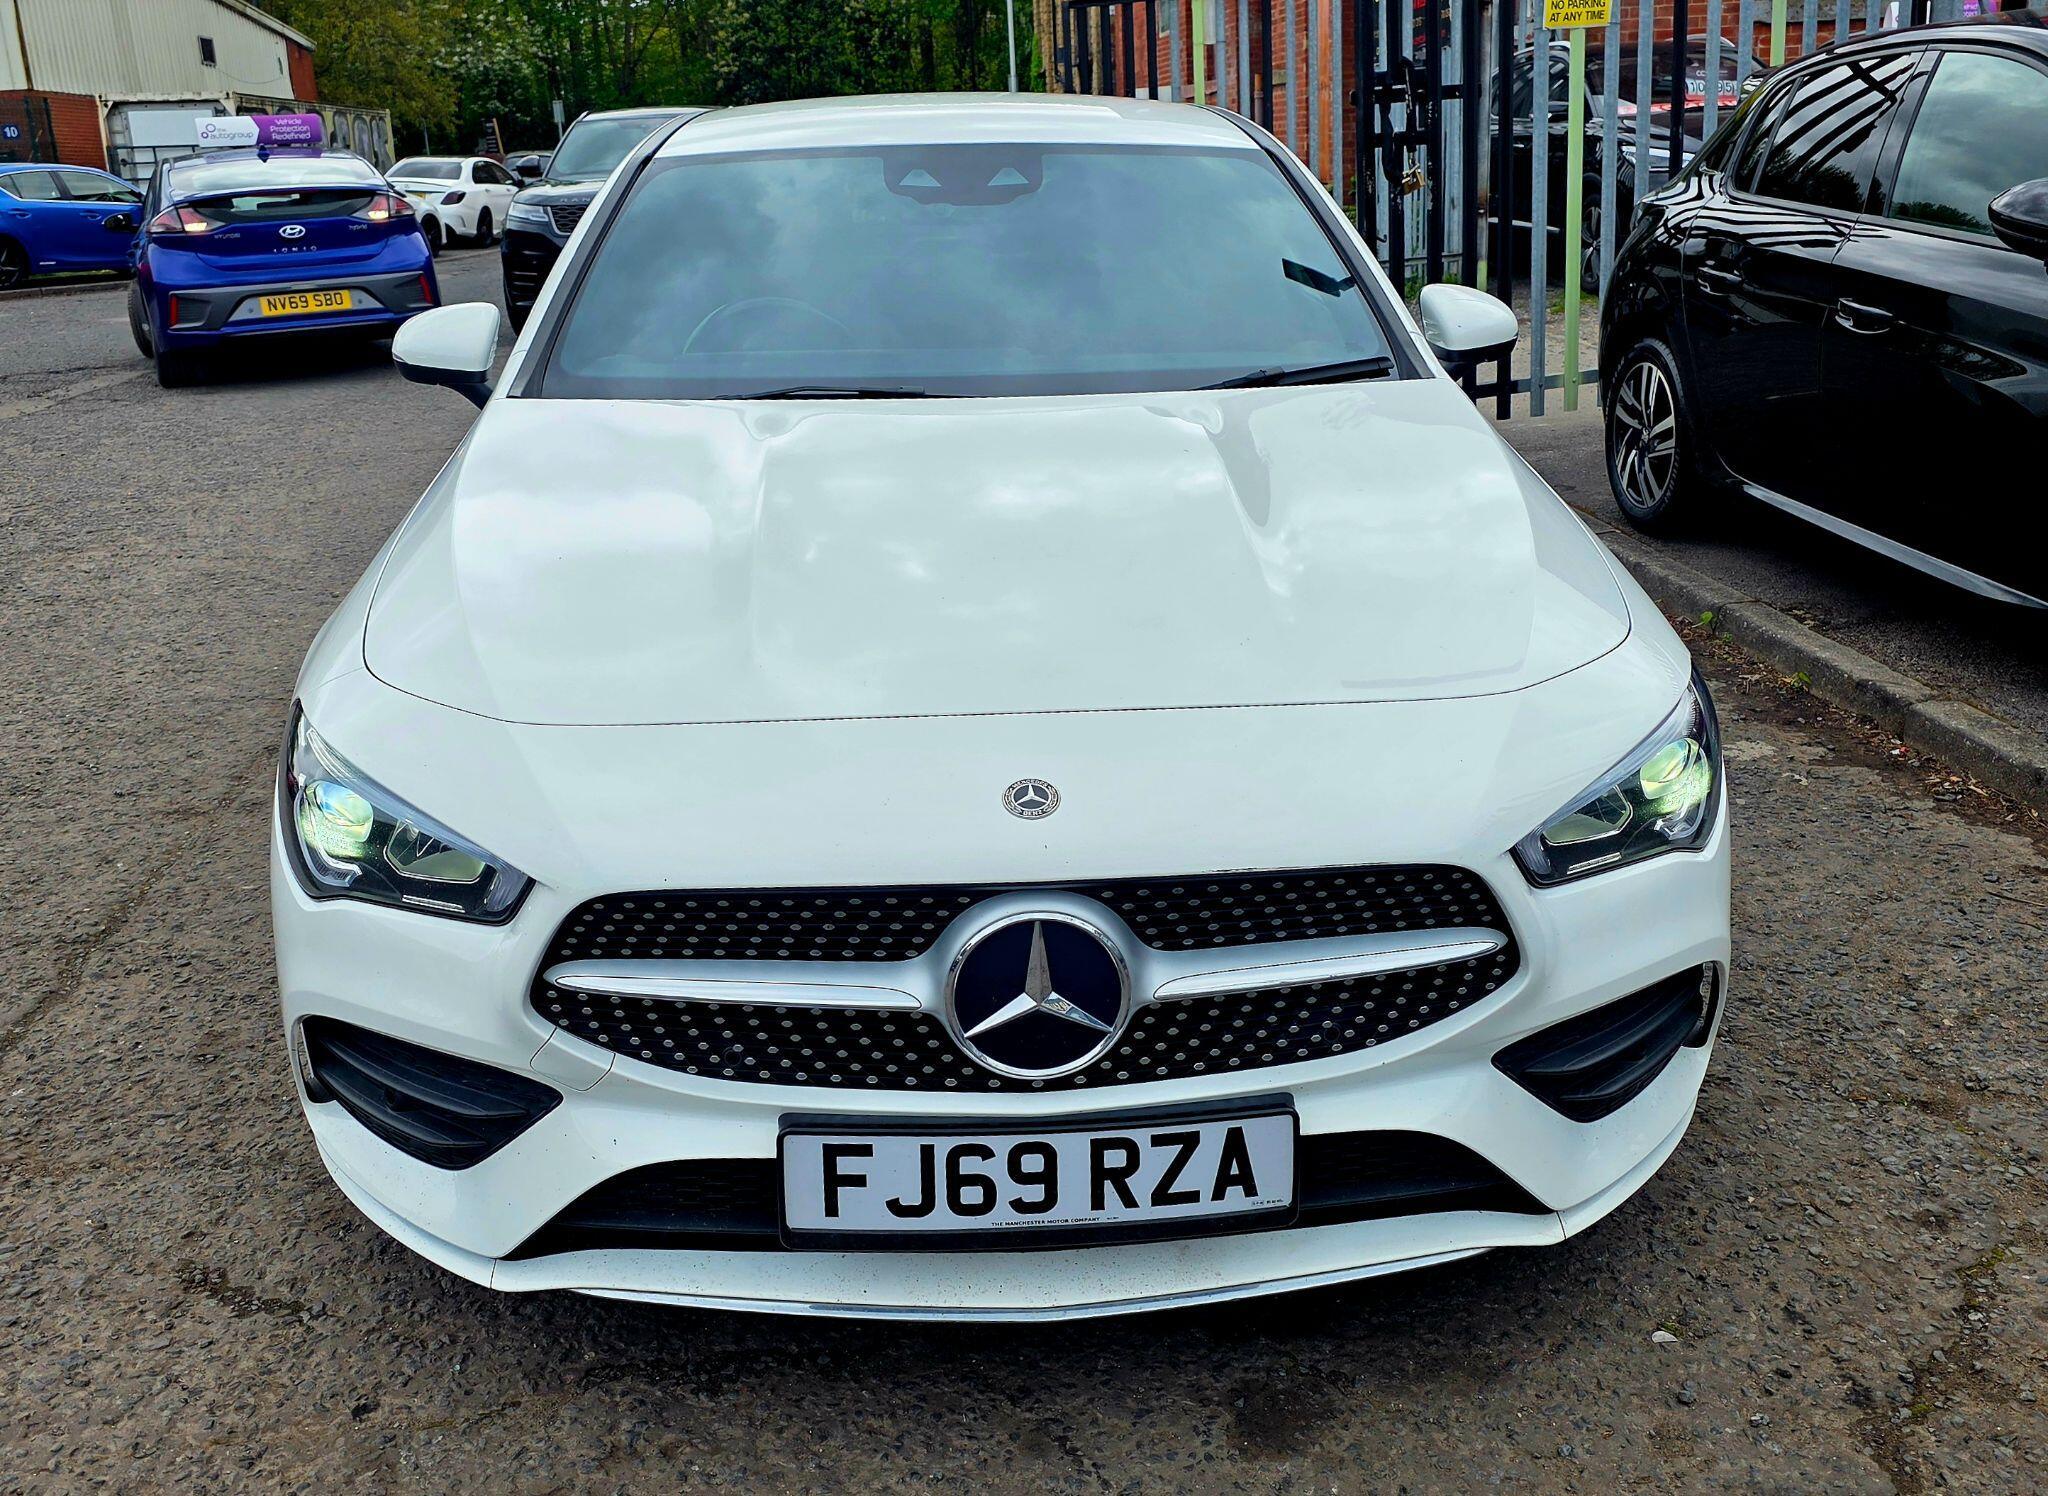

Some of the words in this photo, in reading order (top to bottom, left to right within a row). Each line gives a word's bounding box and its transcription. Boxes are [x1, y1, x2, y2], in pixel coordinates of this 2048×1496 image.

[1551, 0, 1564, 10] NO
[1568, 0, 1606, 9] PARKING
[1550, 13, 1561, 22] AT
[1563, 11, 1582, 21] ANY
[1585, 10, 1605, 20] TIME
[4, 126, 18, 137] 10
[210, 132, 254, 140] autogroup
[272, 132, 311, 140] Redefined
[267, 295, 309, 312] NV69
[313, 291, 344, 307] SBO
[822, 1141, 1058, 1218] FJ69
[1090, 1126, 1260, 1211] RZA
